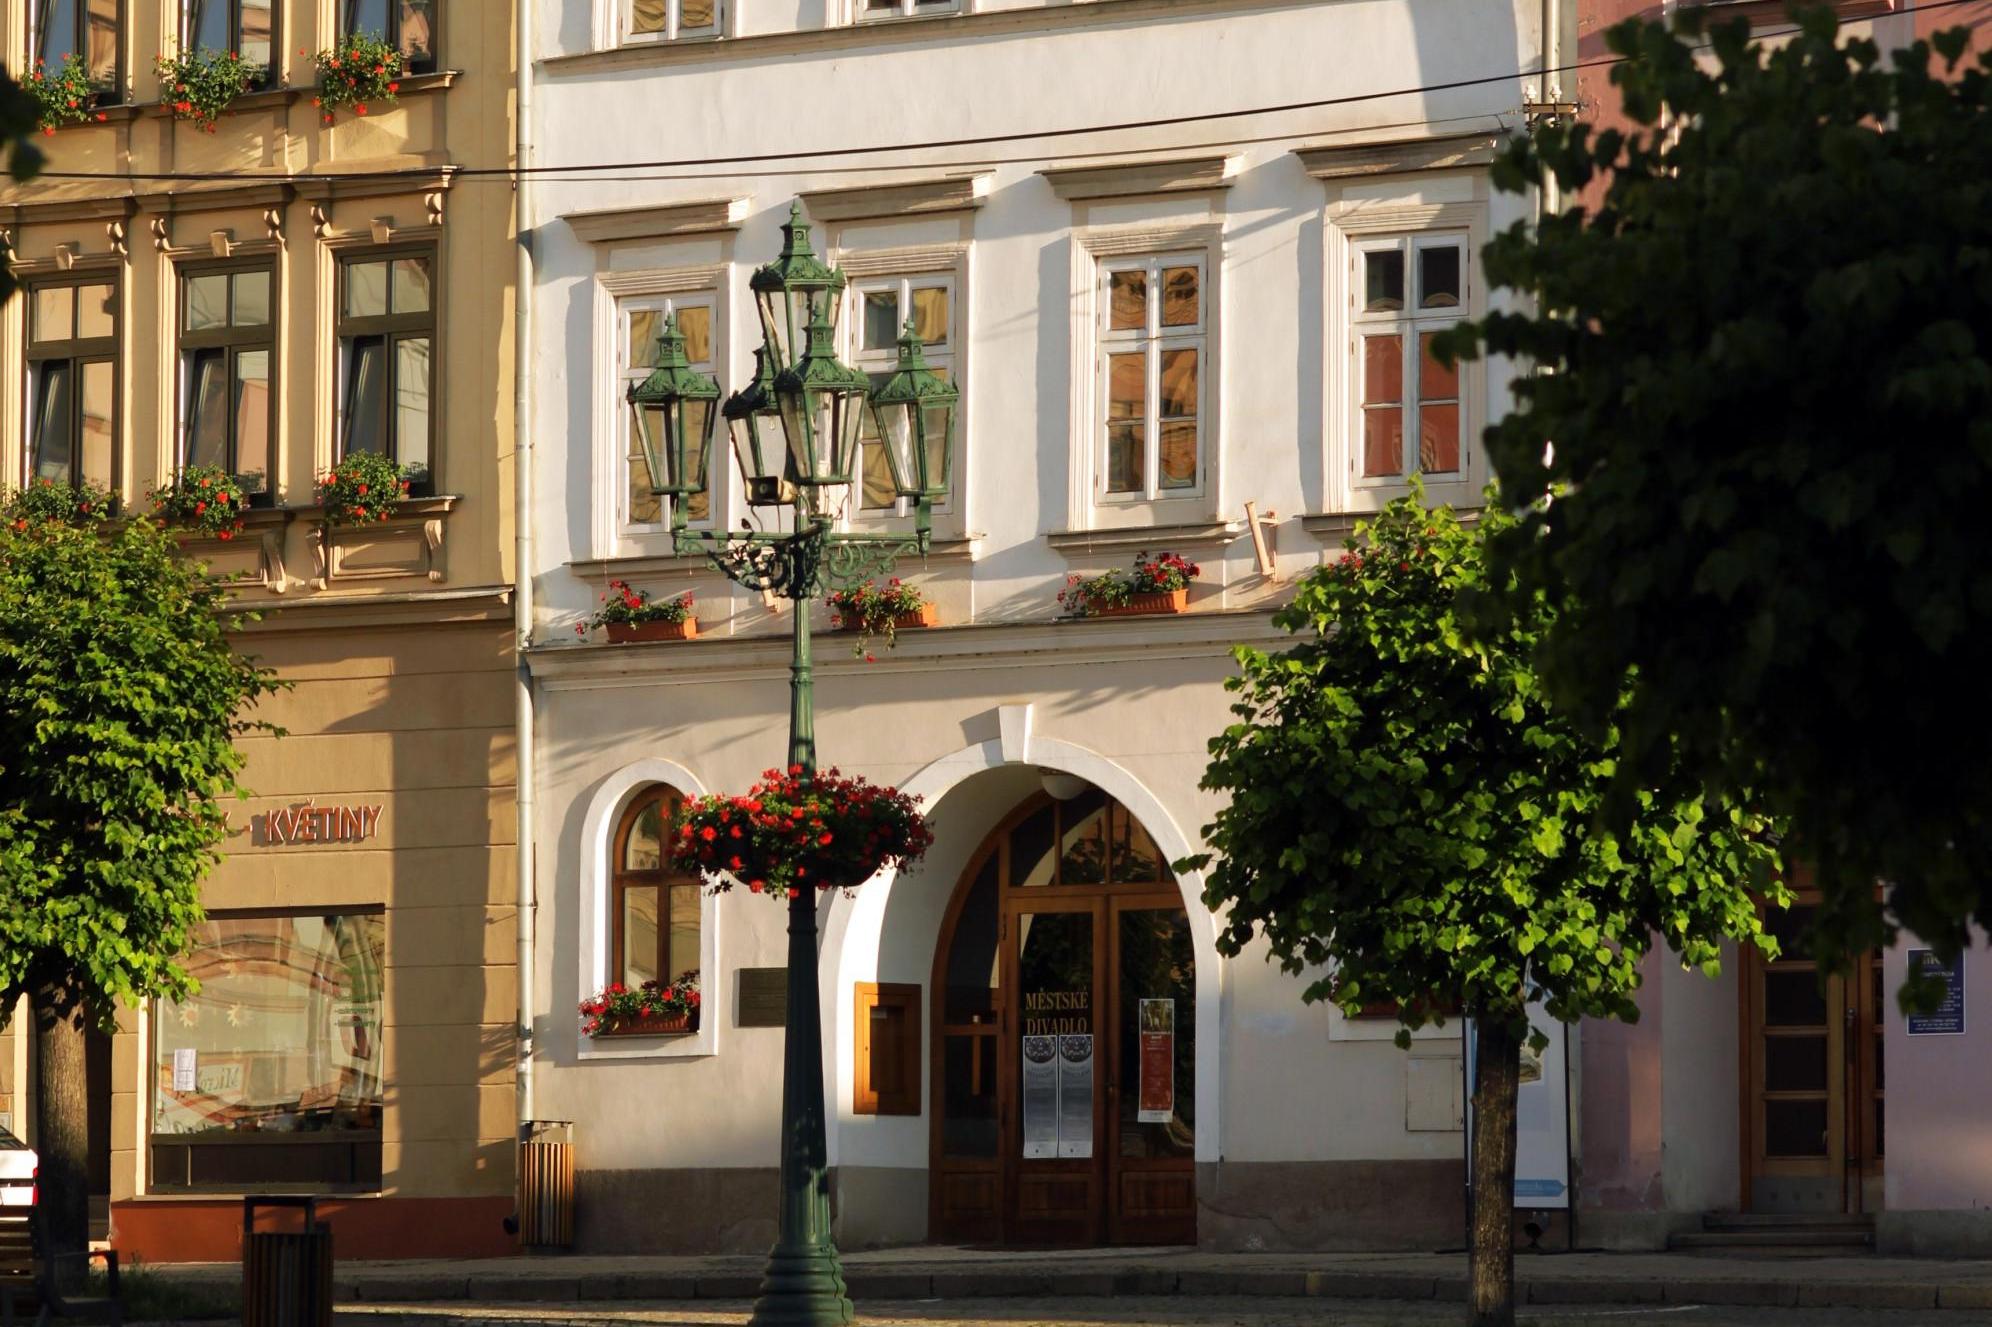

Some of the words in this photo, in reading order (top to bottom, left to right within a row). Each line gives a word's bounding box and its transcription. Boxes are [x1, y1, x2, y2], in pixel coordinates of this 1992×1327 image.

[265, 797, 384, 842] KVĚTINY
[1025, 985, 1088, 1010] MĚSTSKÉ
[1026, 1017, 1088, 1035] DIVADLO
